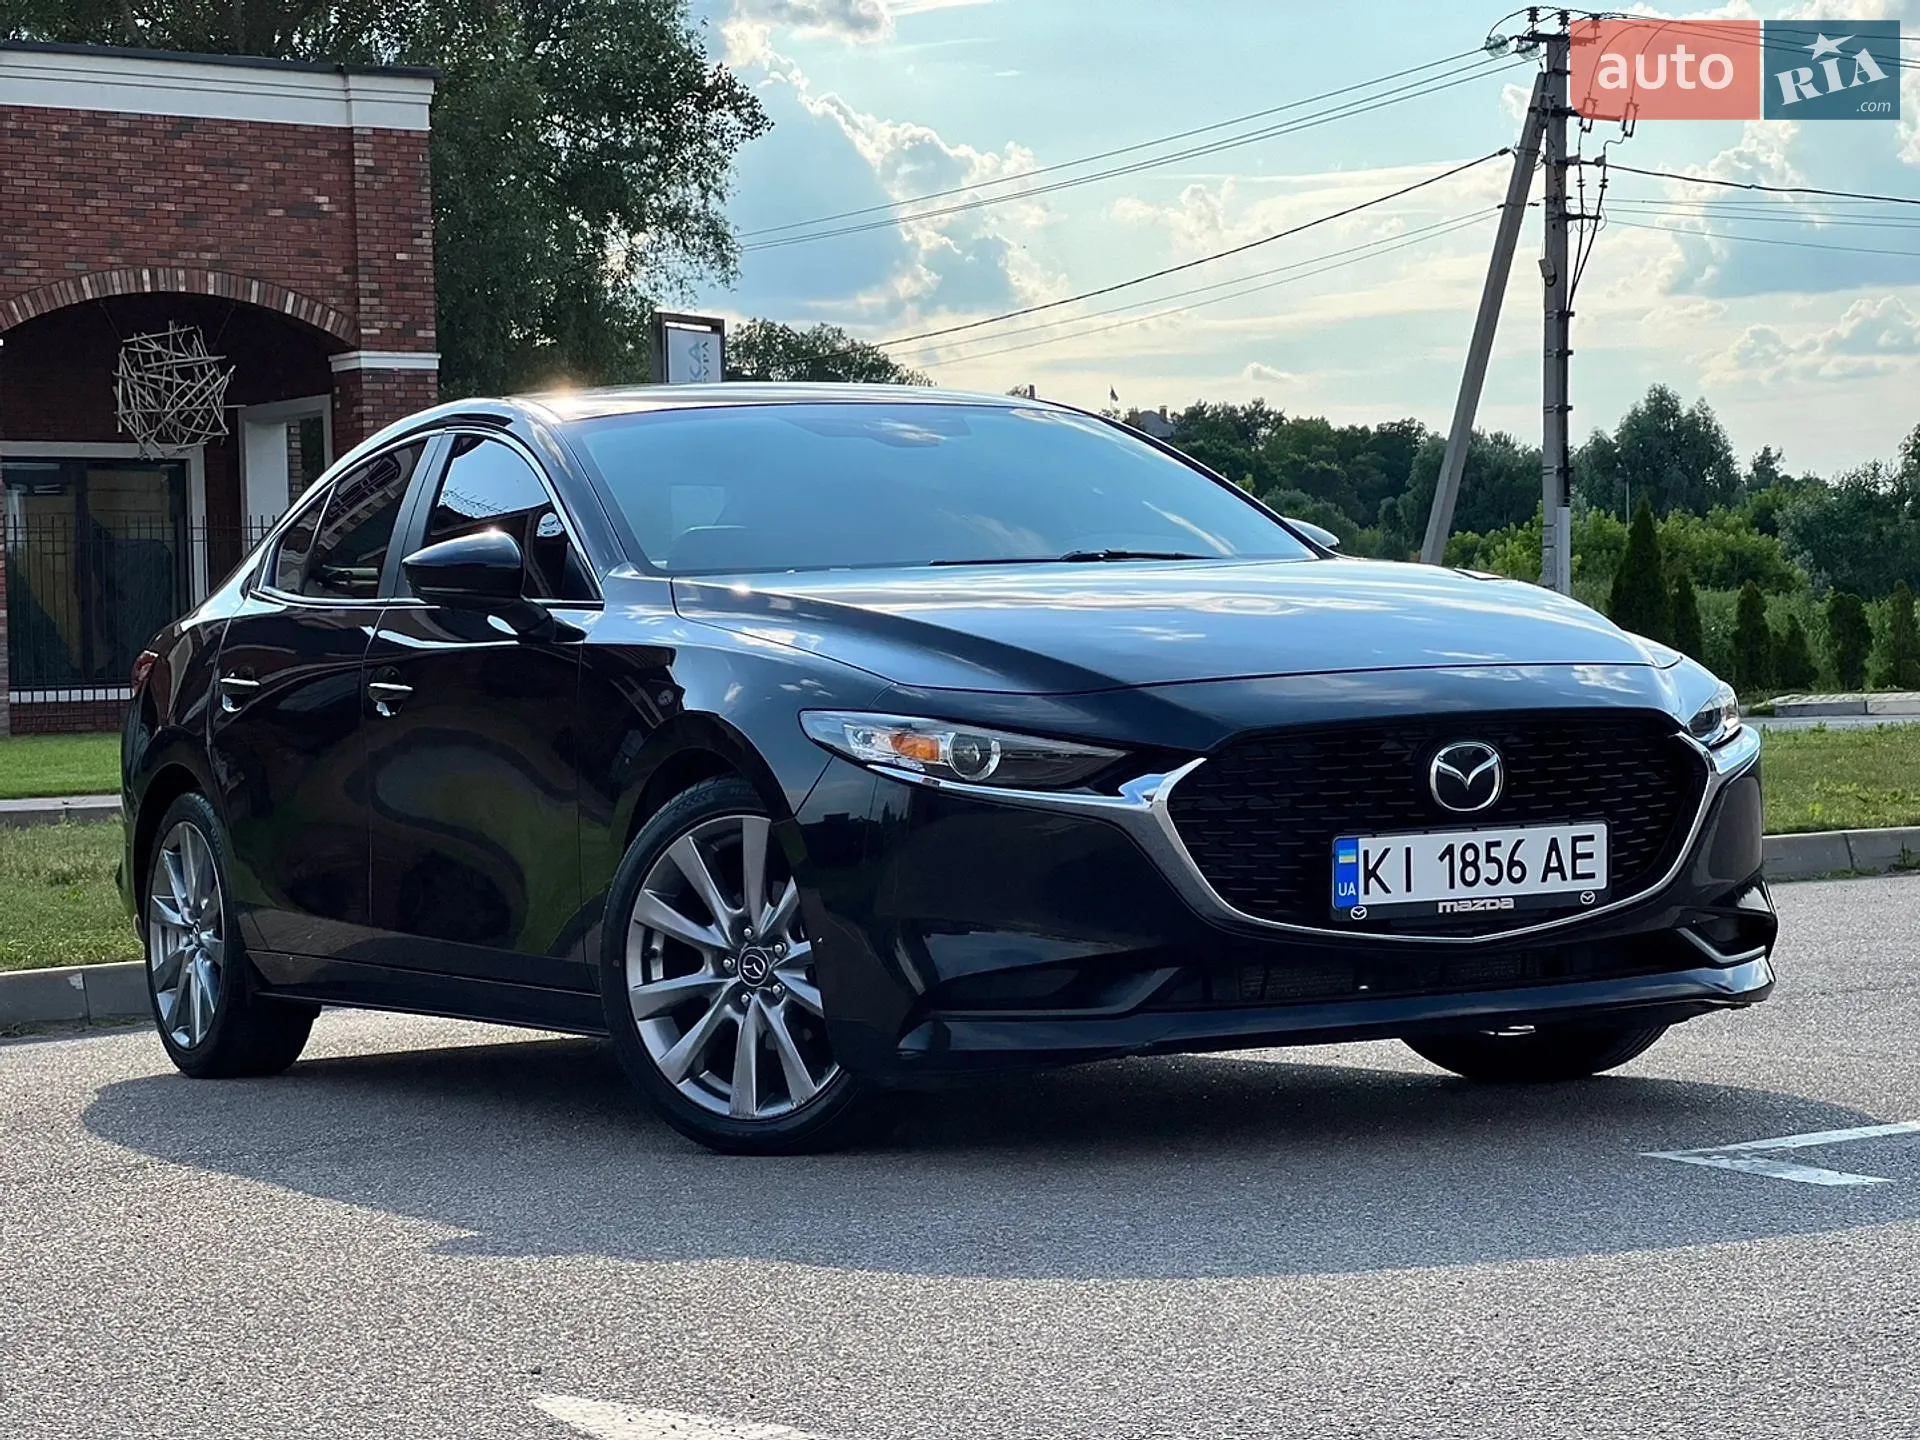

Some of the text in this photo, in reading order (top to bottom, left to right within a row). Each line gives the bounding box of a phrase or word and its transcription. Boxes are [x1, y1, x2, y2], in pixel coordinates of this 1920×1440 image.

[1363, 834, 1596, 896] KI 1856 AE
[1338, 882, 1357, 897] UA
